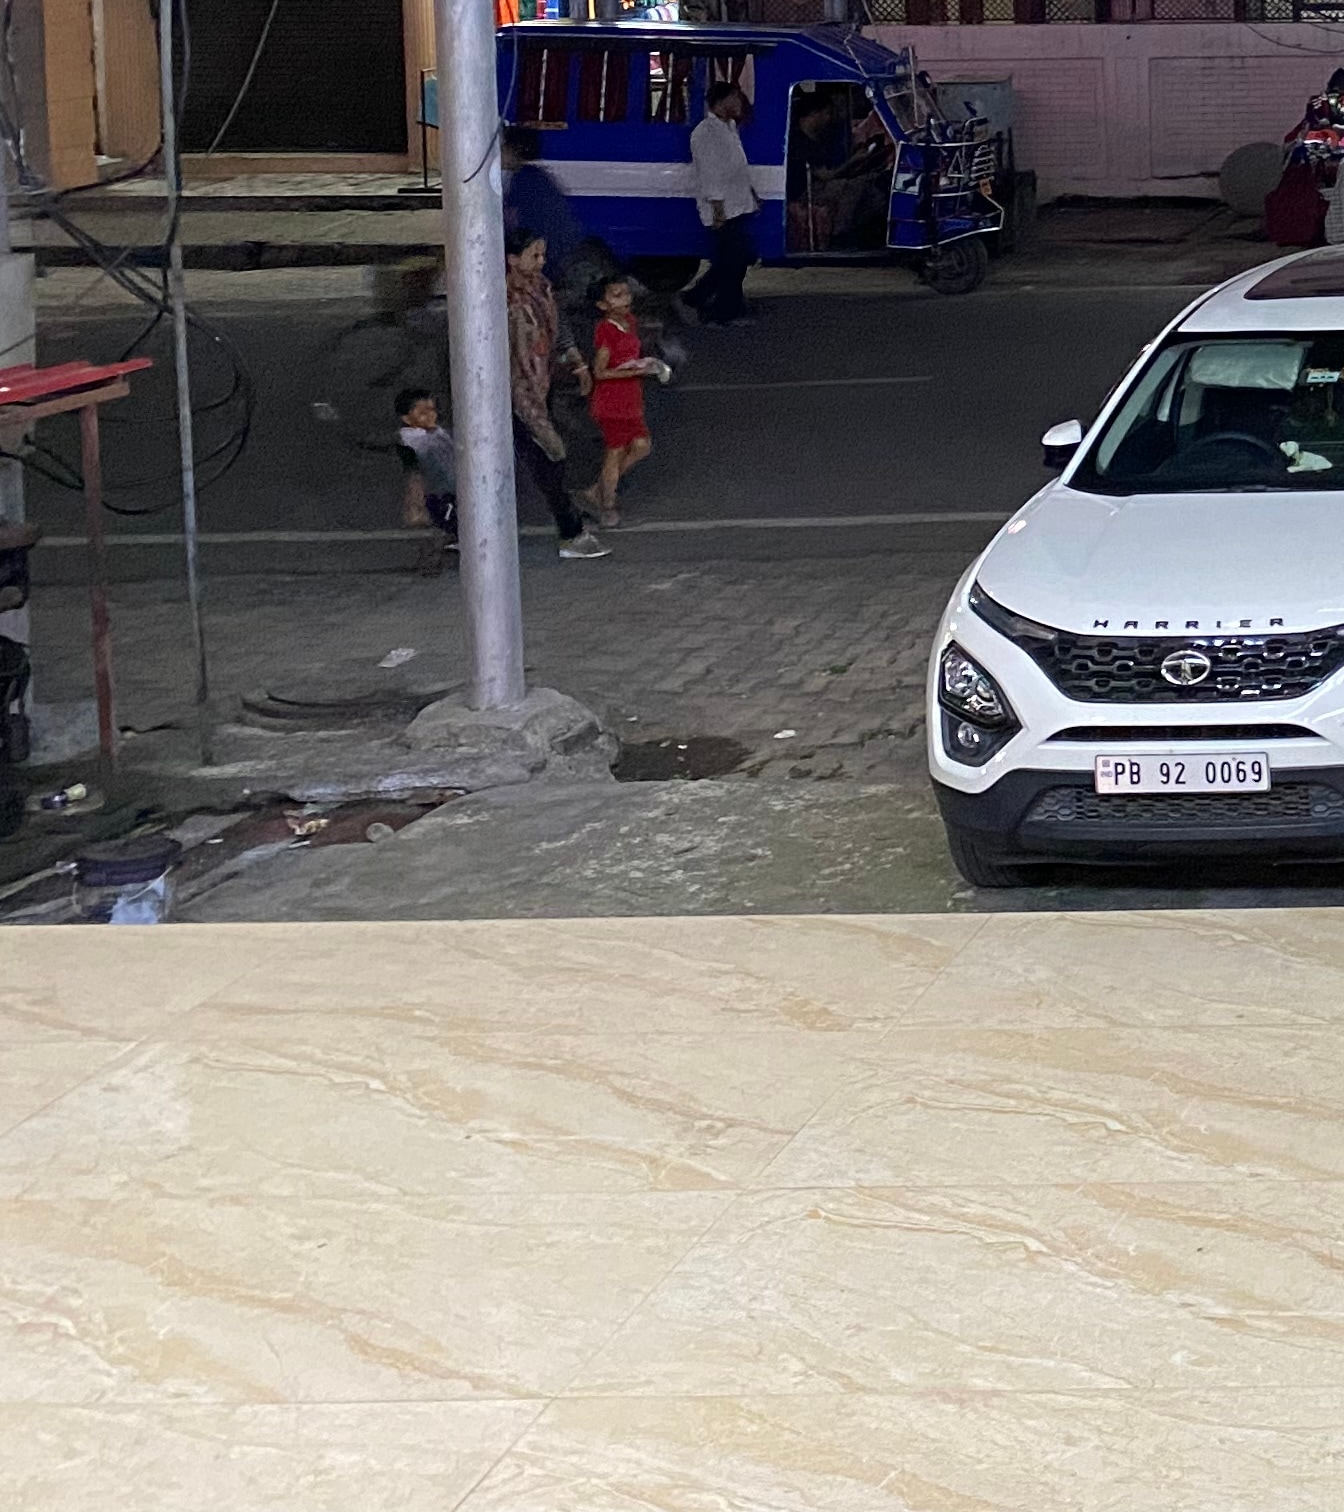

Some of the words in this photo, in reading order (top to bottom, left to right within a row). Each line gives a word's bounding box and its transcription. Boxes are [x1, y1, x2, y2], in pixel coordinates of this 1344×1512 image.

[1093, 618, 1284, 630] HARRIER
[1114, 762, 1141, 785] PB
[1160, 761, 1187, 785] 92
[1205, 760, 1263, 784] 0069
